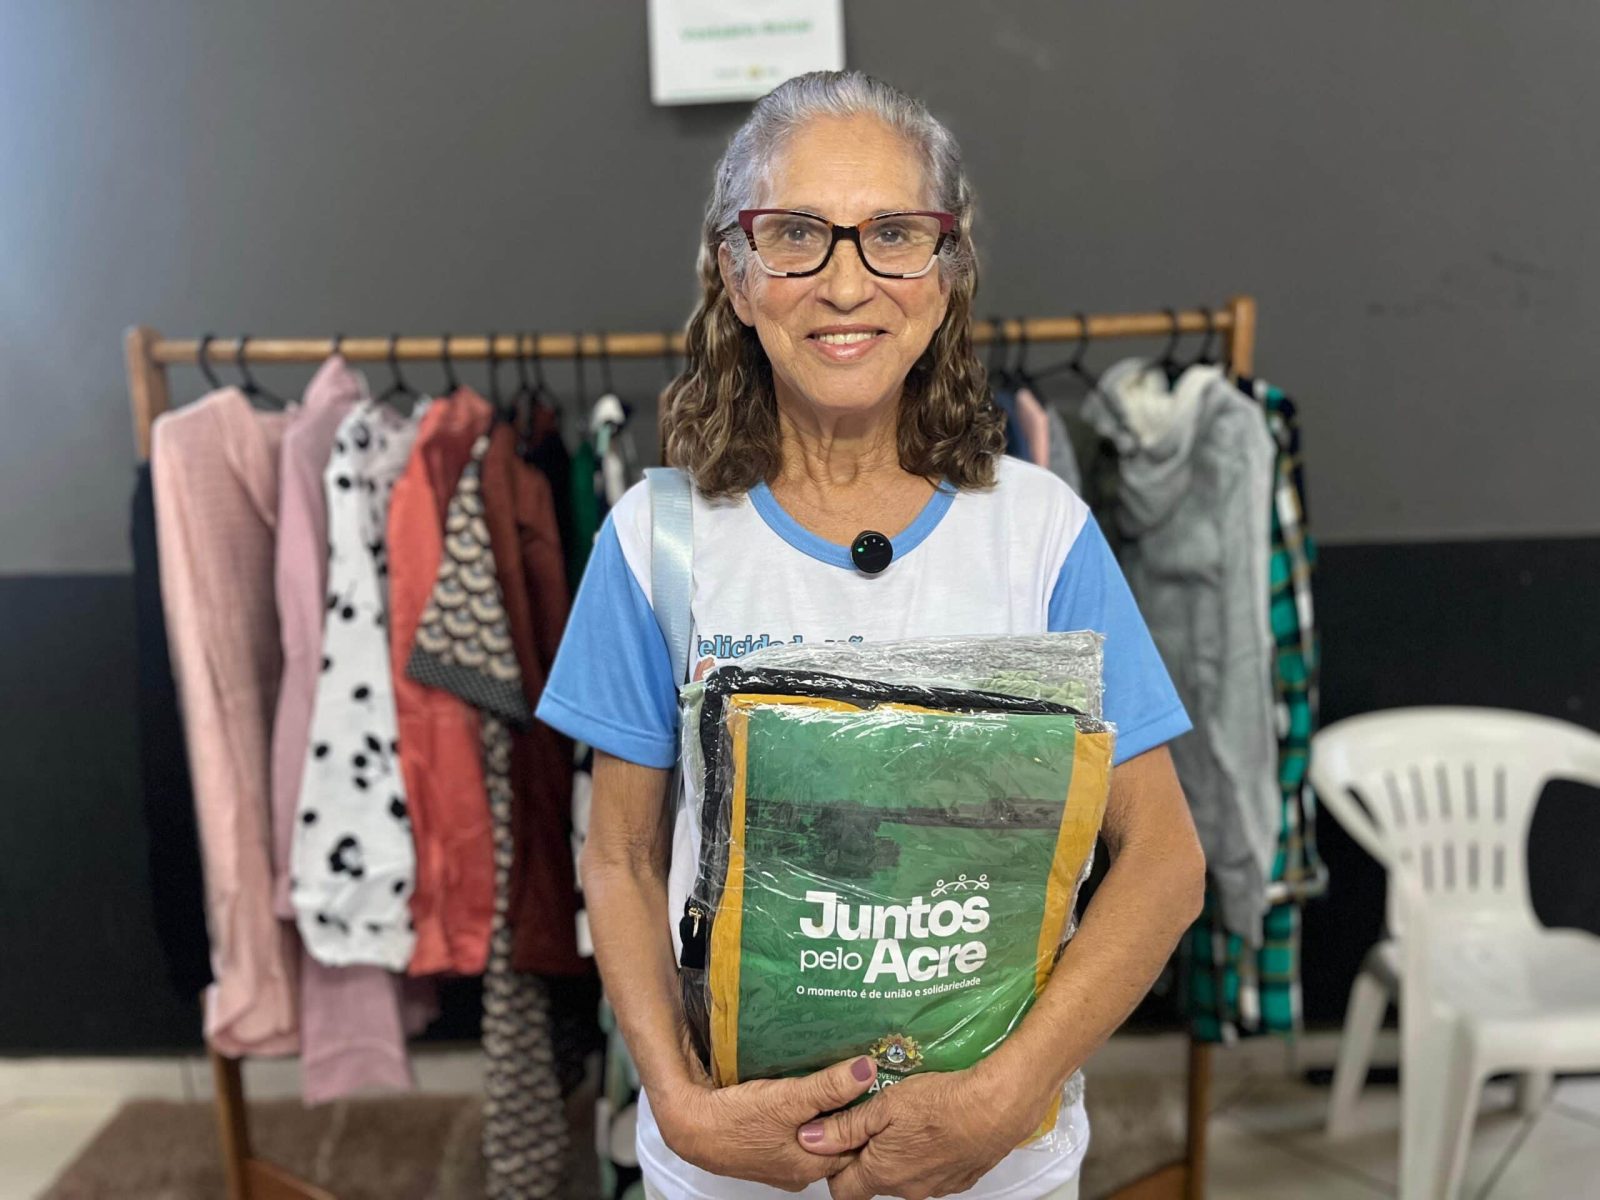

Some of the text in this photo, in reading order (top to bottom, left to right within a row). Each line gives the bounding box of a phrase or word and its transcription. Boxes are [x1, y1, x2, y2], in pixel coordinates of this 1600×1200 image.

[799, 890, 990, 941] Juntos
[800, 939, 987, 984] pelo Acre
[796, 977, 981, 998] O momento é de união e solidariedade
